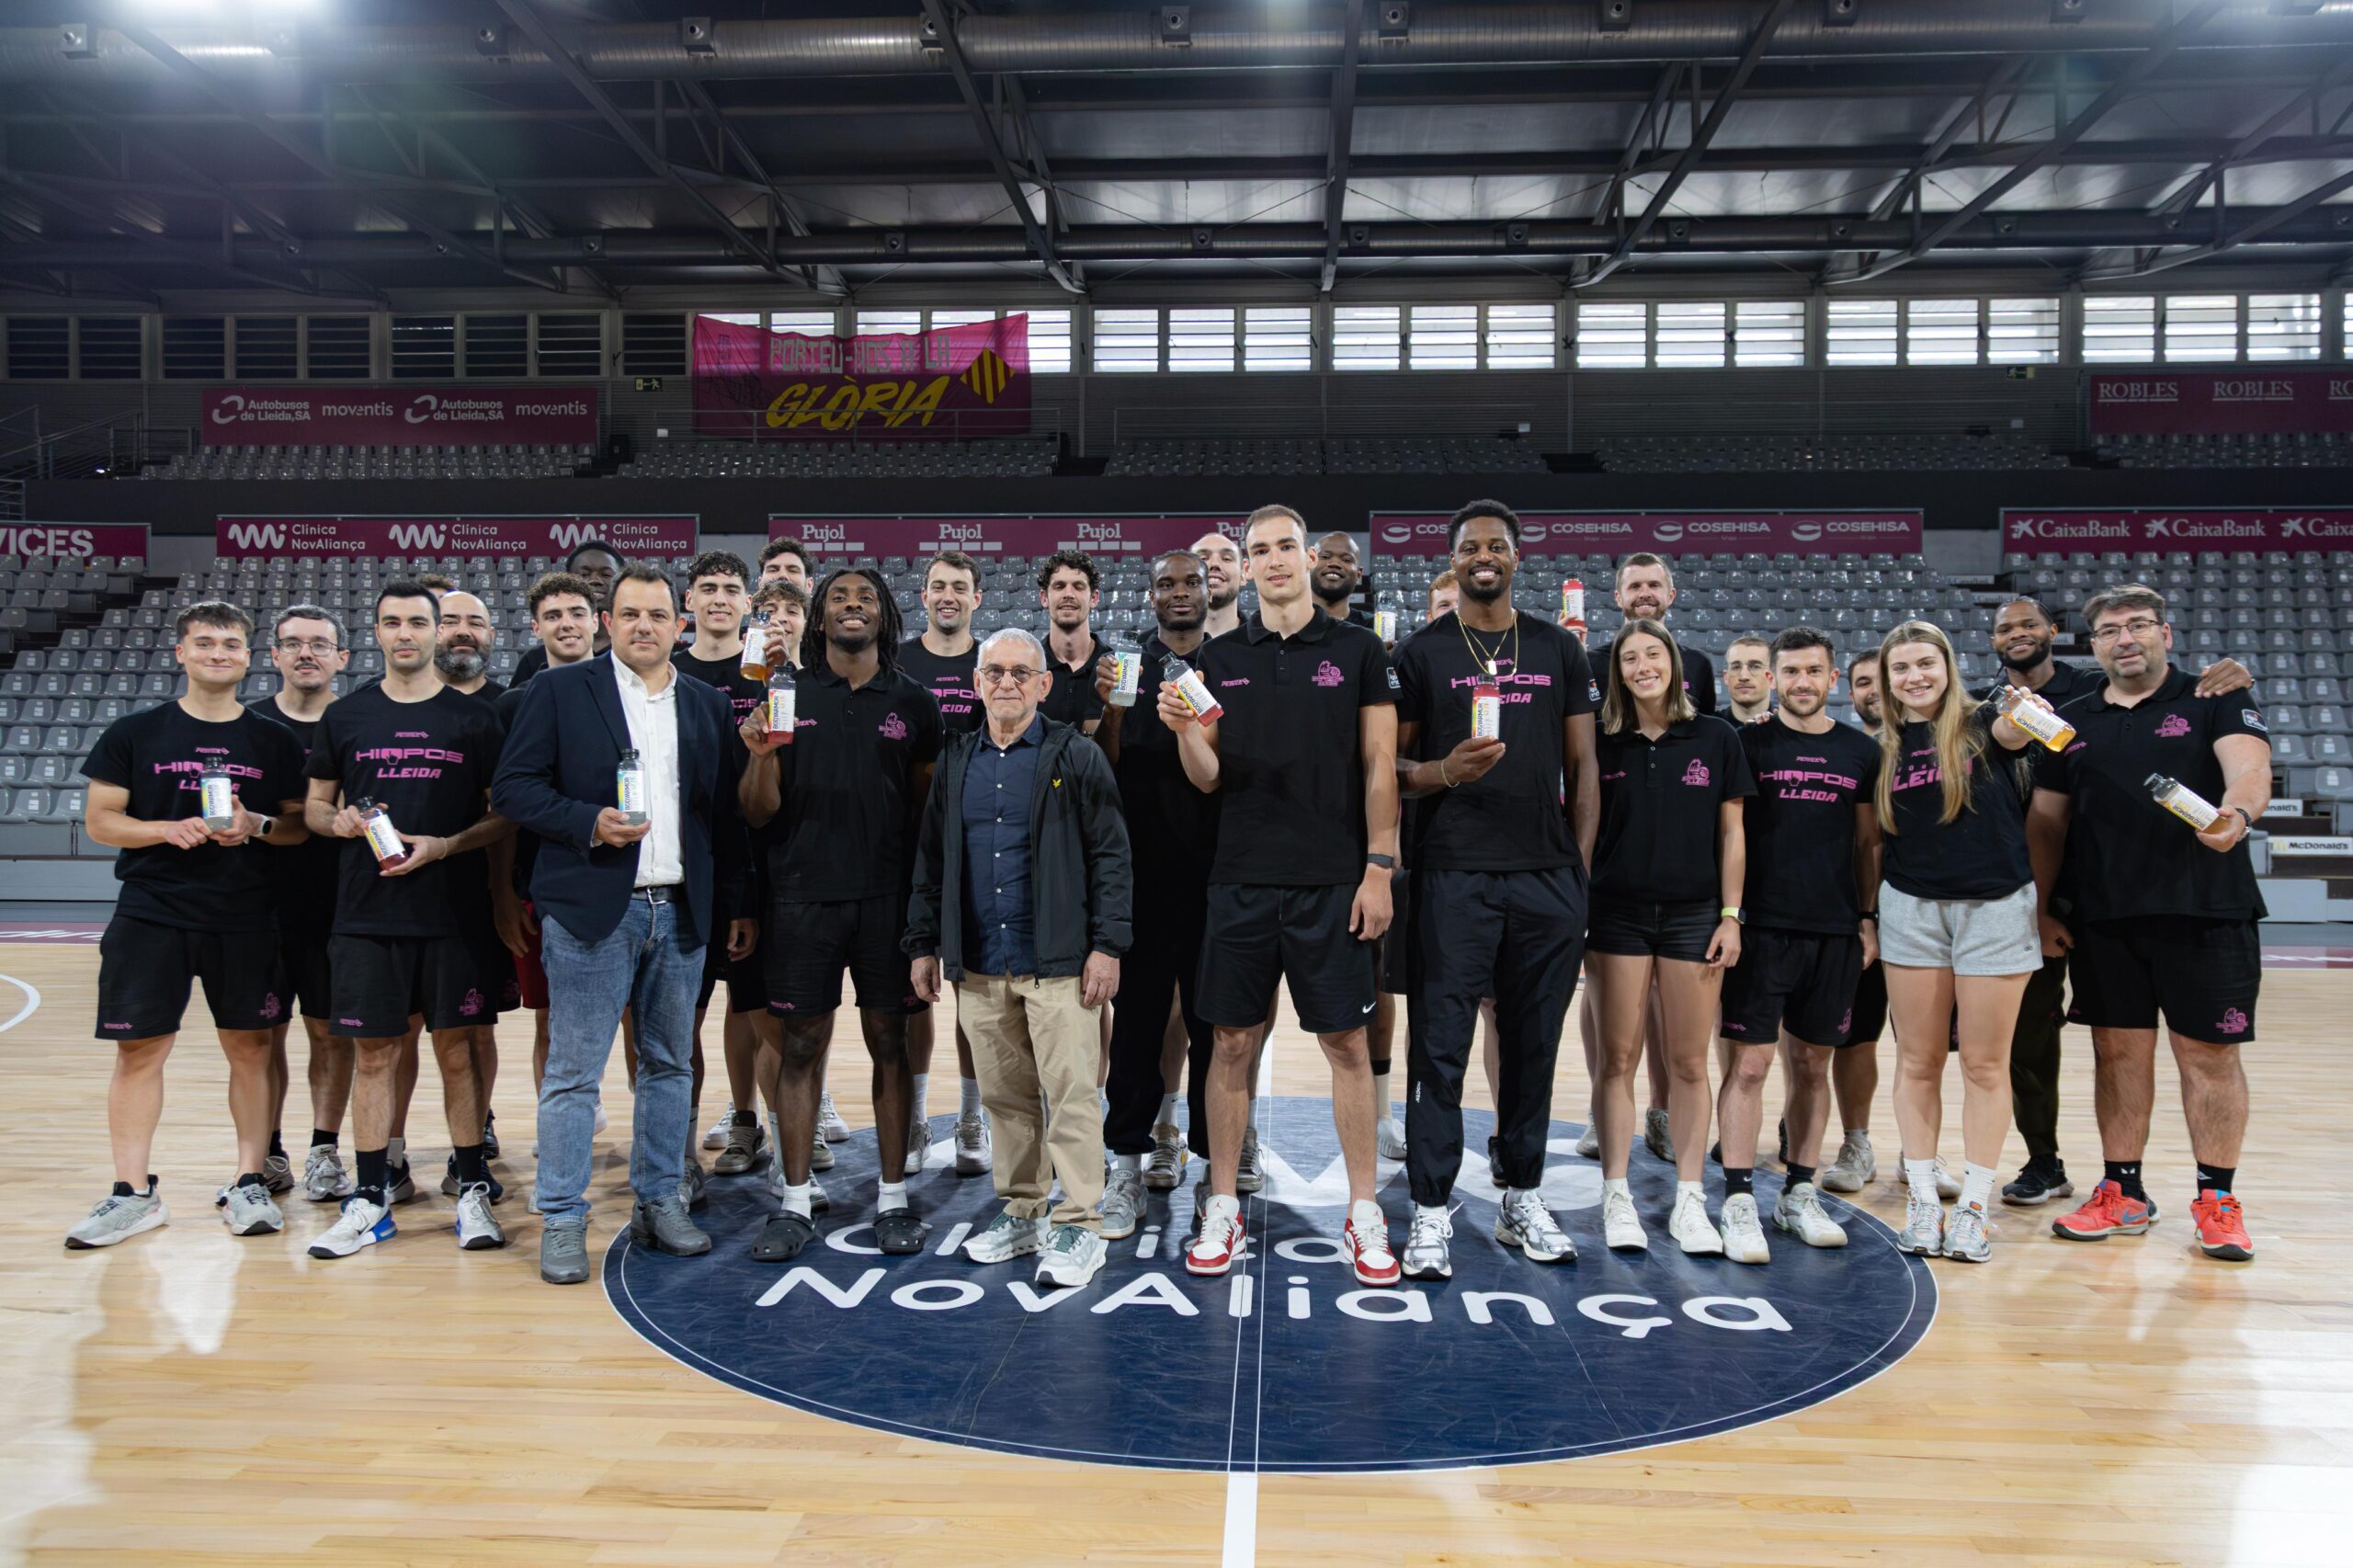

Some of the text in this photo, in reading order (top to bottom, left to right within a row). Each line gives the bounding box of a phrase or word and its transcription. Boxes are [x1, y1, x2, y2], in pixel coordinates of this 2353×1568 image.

[925, 335, 950, 369] LA
[2098, 381, 2178, 398] ROBLES
[2213, 381, 2293, 398] ROBLES
[248, 400, 310, 411] Autobusos
[323, 402, 393, 416] moventis
[441, 400, 504, 410] Autobusos
[516, 401, 588, 415] moventis
[766, 374, 950, 431] GLÒRIA
[241, 412, 255, 422] de
[434, 411, 448, 421] de
[291, 523, 336, 535] Clínica
[452, 523, 498, 535] Clínica
[612, 523, 658, 535] Clínica
[801, 524, 846, 542] Pujol
[938, 524, 983, 542] Pujol
[1076, 523, 1121, 541] Pujol
[1217, 522, 1246, 538] Puj
[1552, 523, 1633, 533] COSEHISA
[1688, 522, 1771, 533] COSEHISA
[1826, 521, 1911, 532] COSEHISA
[2038, 519, 2131, 538] CaixaBank
[2172, 519, 2266, 537] CaixaBank
[291, 539, 366, 551] NovAliança
[452, 539, 527, 551] NovAliança
[612, 539, 687, 551] NovAliança
[1120, 658, 1129, 690] BODYARMOR
[1177, 683, 1203, 713] BODYARMOR
[772, 695, 780, 729] BODYARMOR
[941, 704, 972, 714] EIDA
[2015, 715, 2051, 741] BODYARMOR
[377, 767, 443, 778] LLEIDA
[1779, 789, 1837, 802] LLEIDA
[2289, 842, 2349, 850] McDonald's
[754, 1267, 1793, 1338] NovAliança
